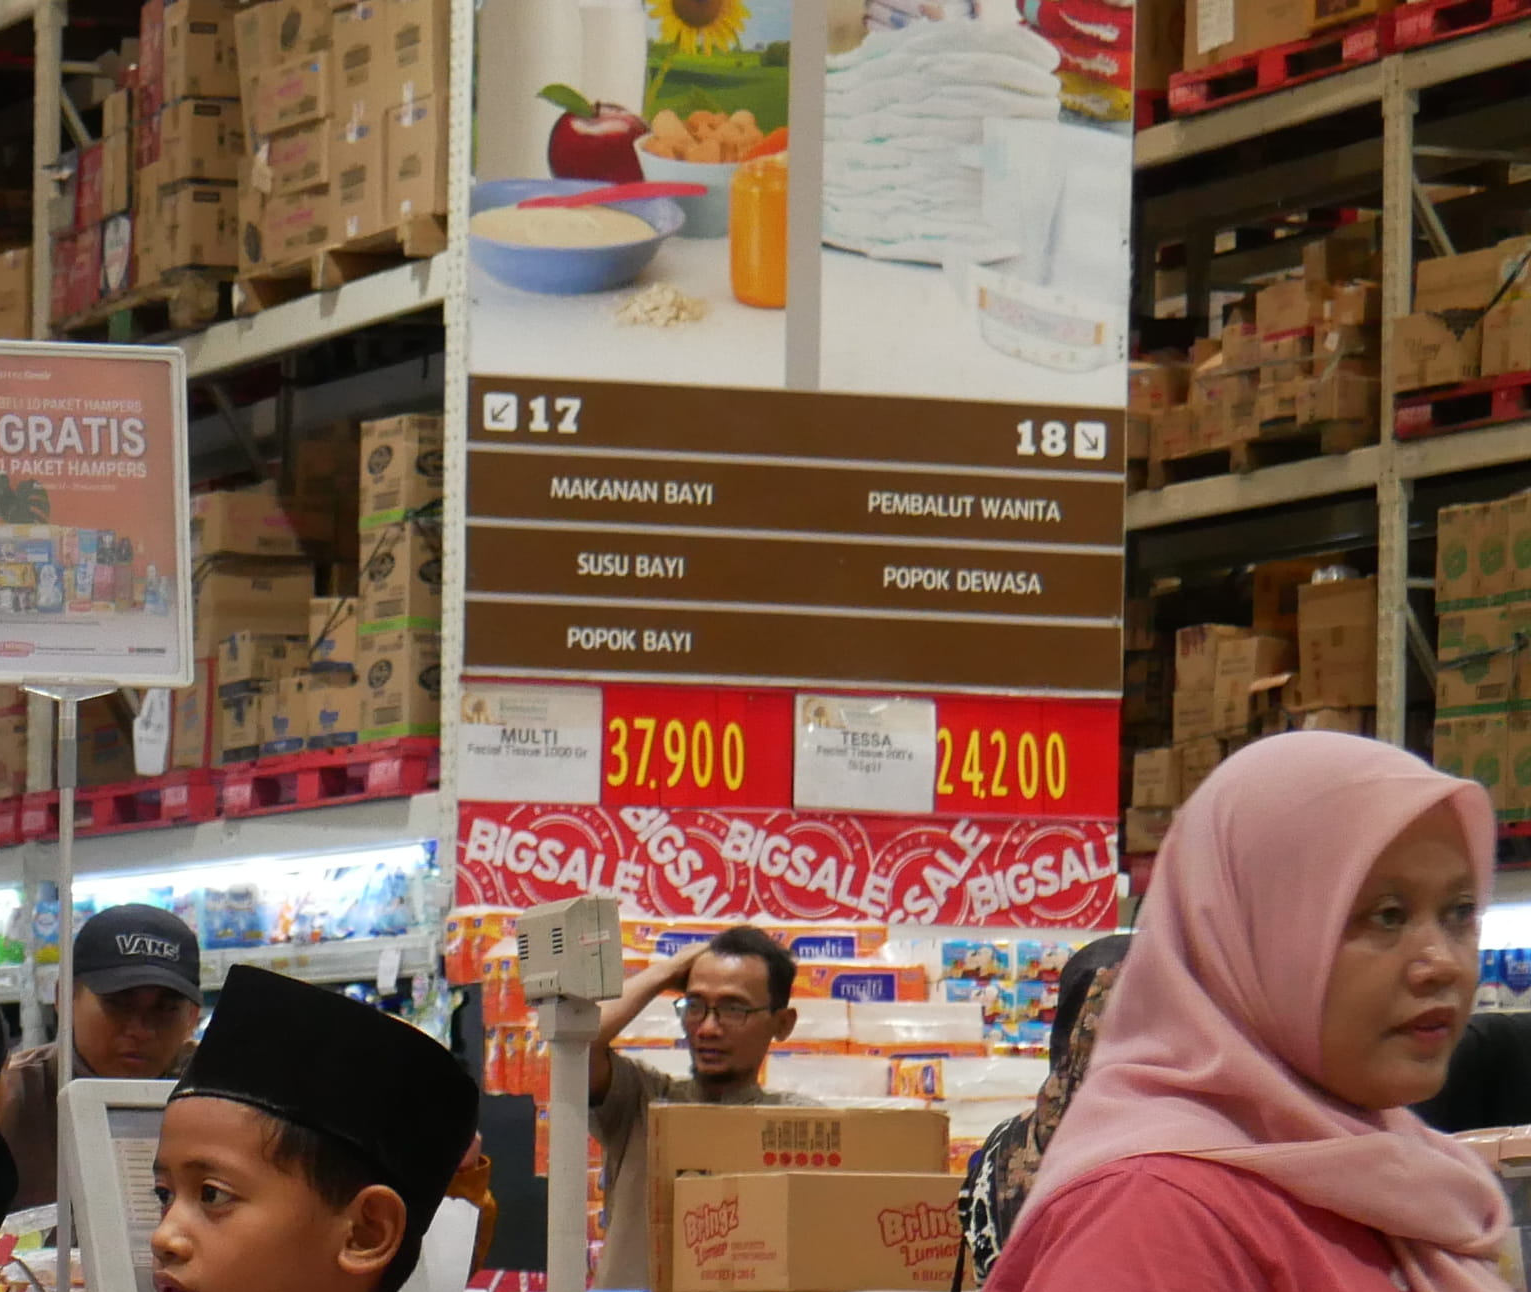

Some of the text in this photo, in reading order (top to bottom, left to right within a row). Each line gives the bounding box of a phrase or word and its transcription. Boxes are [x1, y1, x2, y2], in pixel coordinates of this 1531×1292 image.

[529, 398, 581, 434] 17
[1016, 420, 1067, 457] 18
[10, 459, 64, 477] PAKET
[67, 460, 147, 479] HAMPERS
[550, 475, 713, 505] MAKANAN BAYI
[868, 492, 1061, 522] PEMBALUT WANITA
[576, 552, 685, 579] SUSU BAYI
[882, 566, 1041, 595] POPOK DEWASA
[566, 626, 693, 655] POPOK BAYI
[500, 717, 745, 791] MULTI 37.900
[841, 728, 1067, 800] TESSA 24.200
[465, 817, 644, 905] BIGSALE
[720, 817, 892, 918] BIGSALE
[115, 933, 180, 962] VANS
[797, 939, 843, 958] multi
[841, 974, 884, 1000] multi
